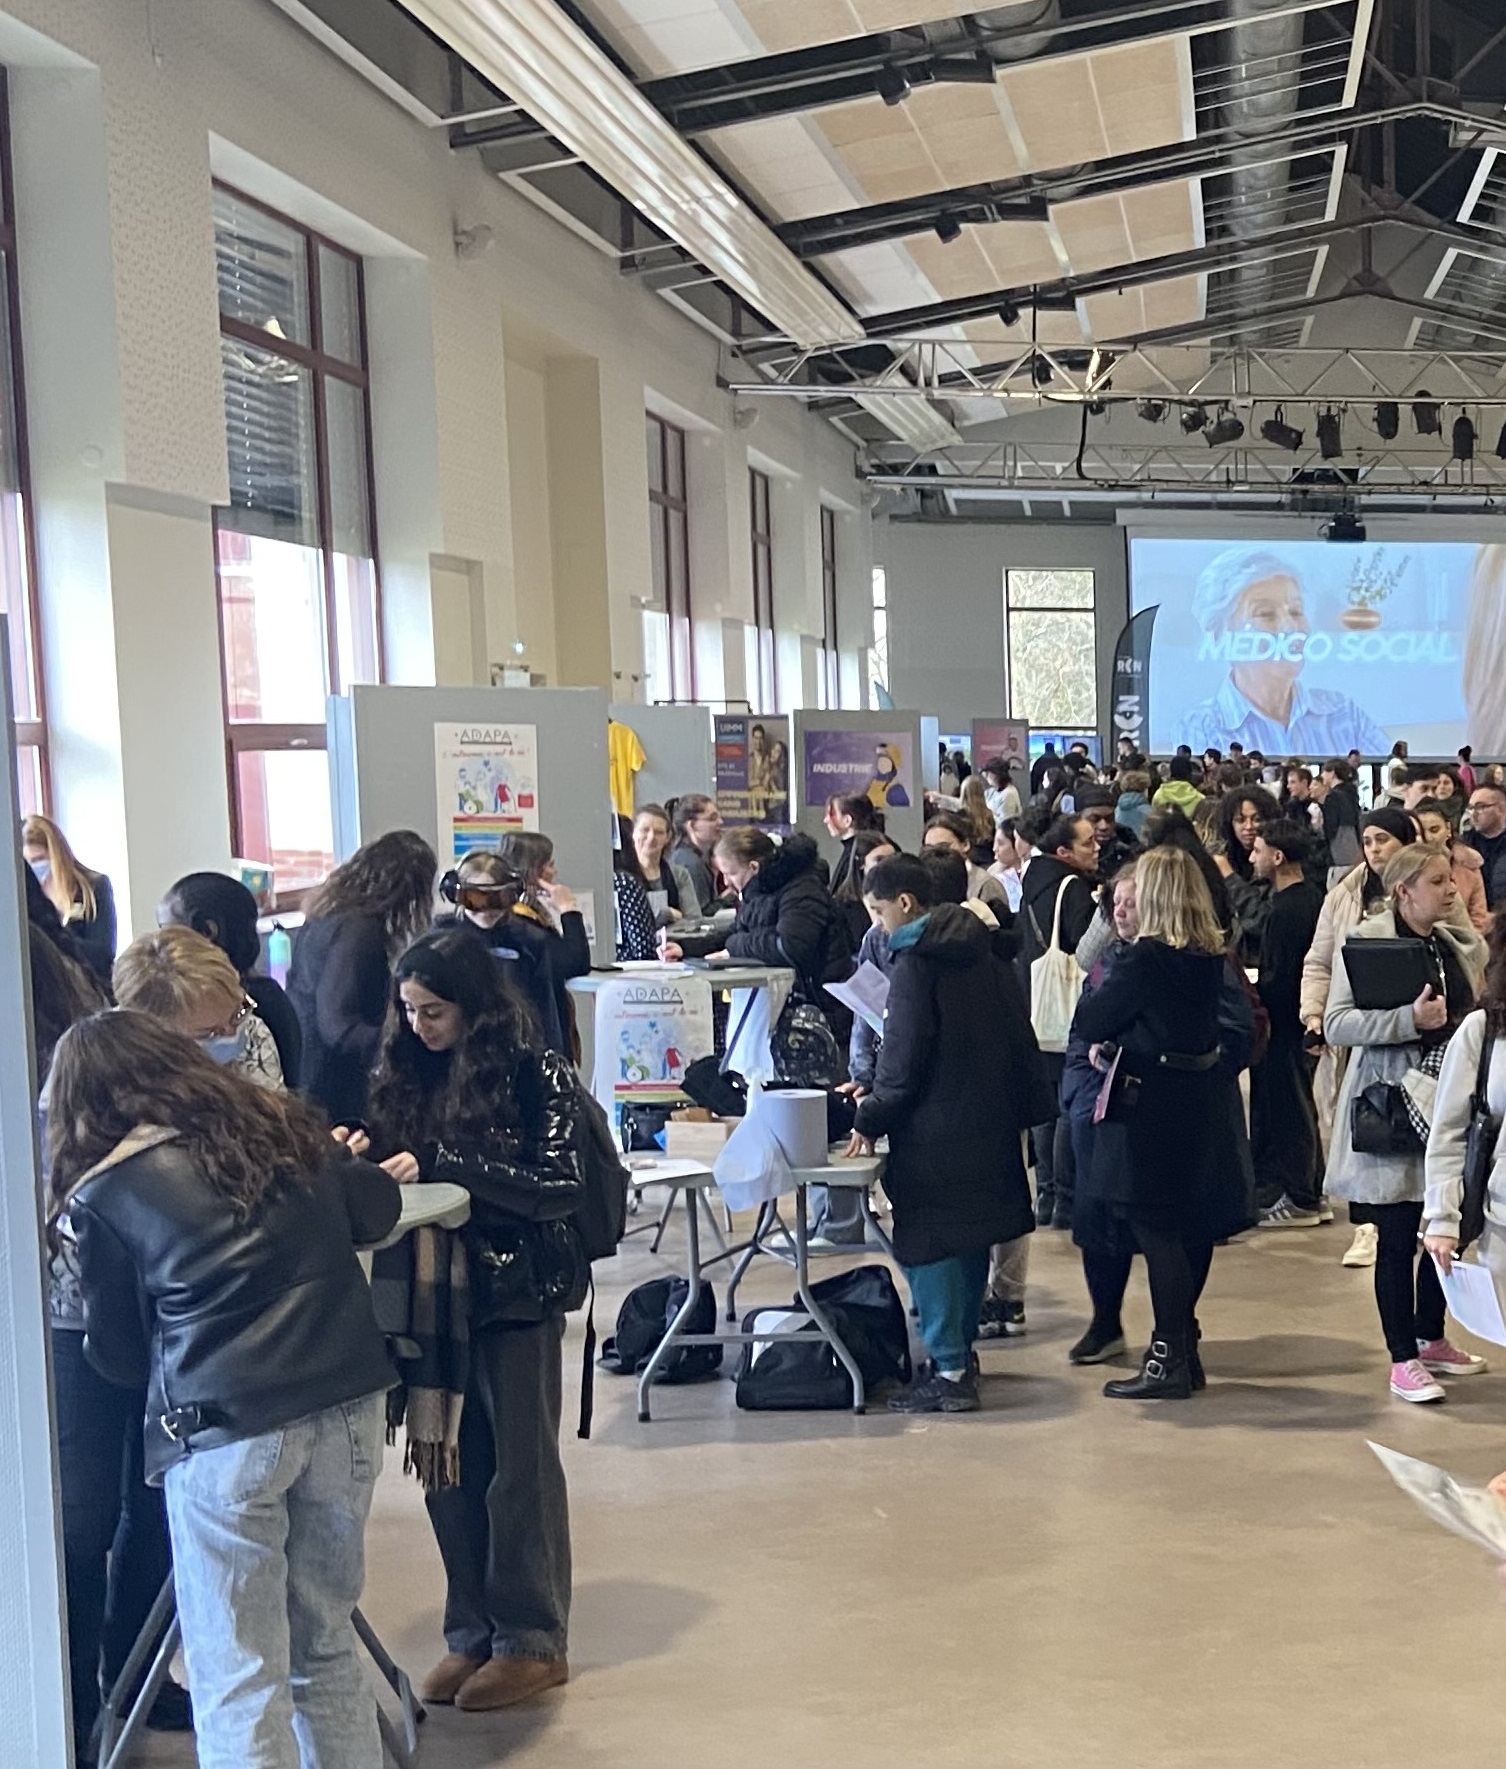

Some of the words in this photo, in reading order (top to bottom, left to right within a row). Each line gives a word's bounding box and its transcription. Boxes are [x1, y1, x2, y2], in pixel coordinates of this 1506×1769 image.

[1198, 623, 1333, 662] MÉDICO
[1337, 631, 1458, 662] SOCIAL
[460, 729, 512, 741] ADAPA
[813, 763, 873, 774] INDUSTRIE
[623, 987, 682, 1000] ADAPA
